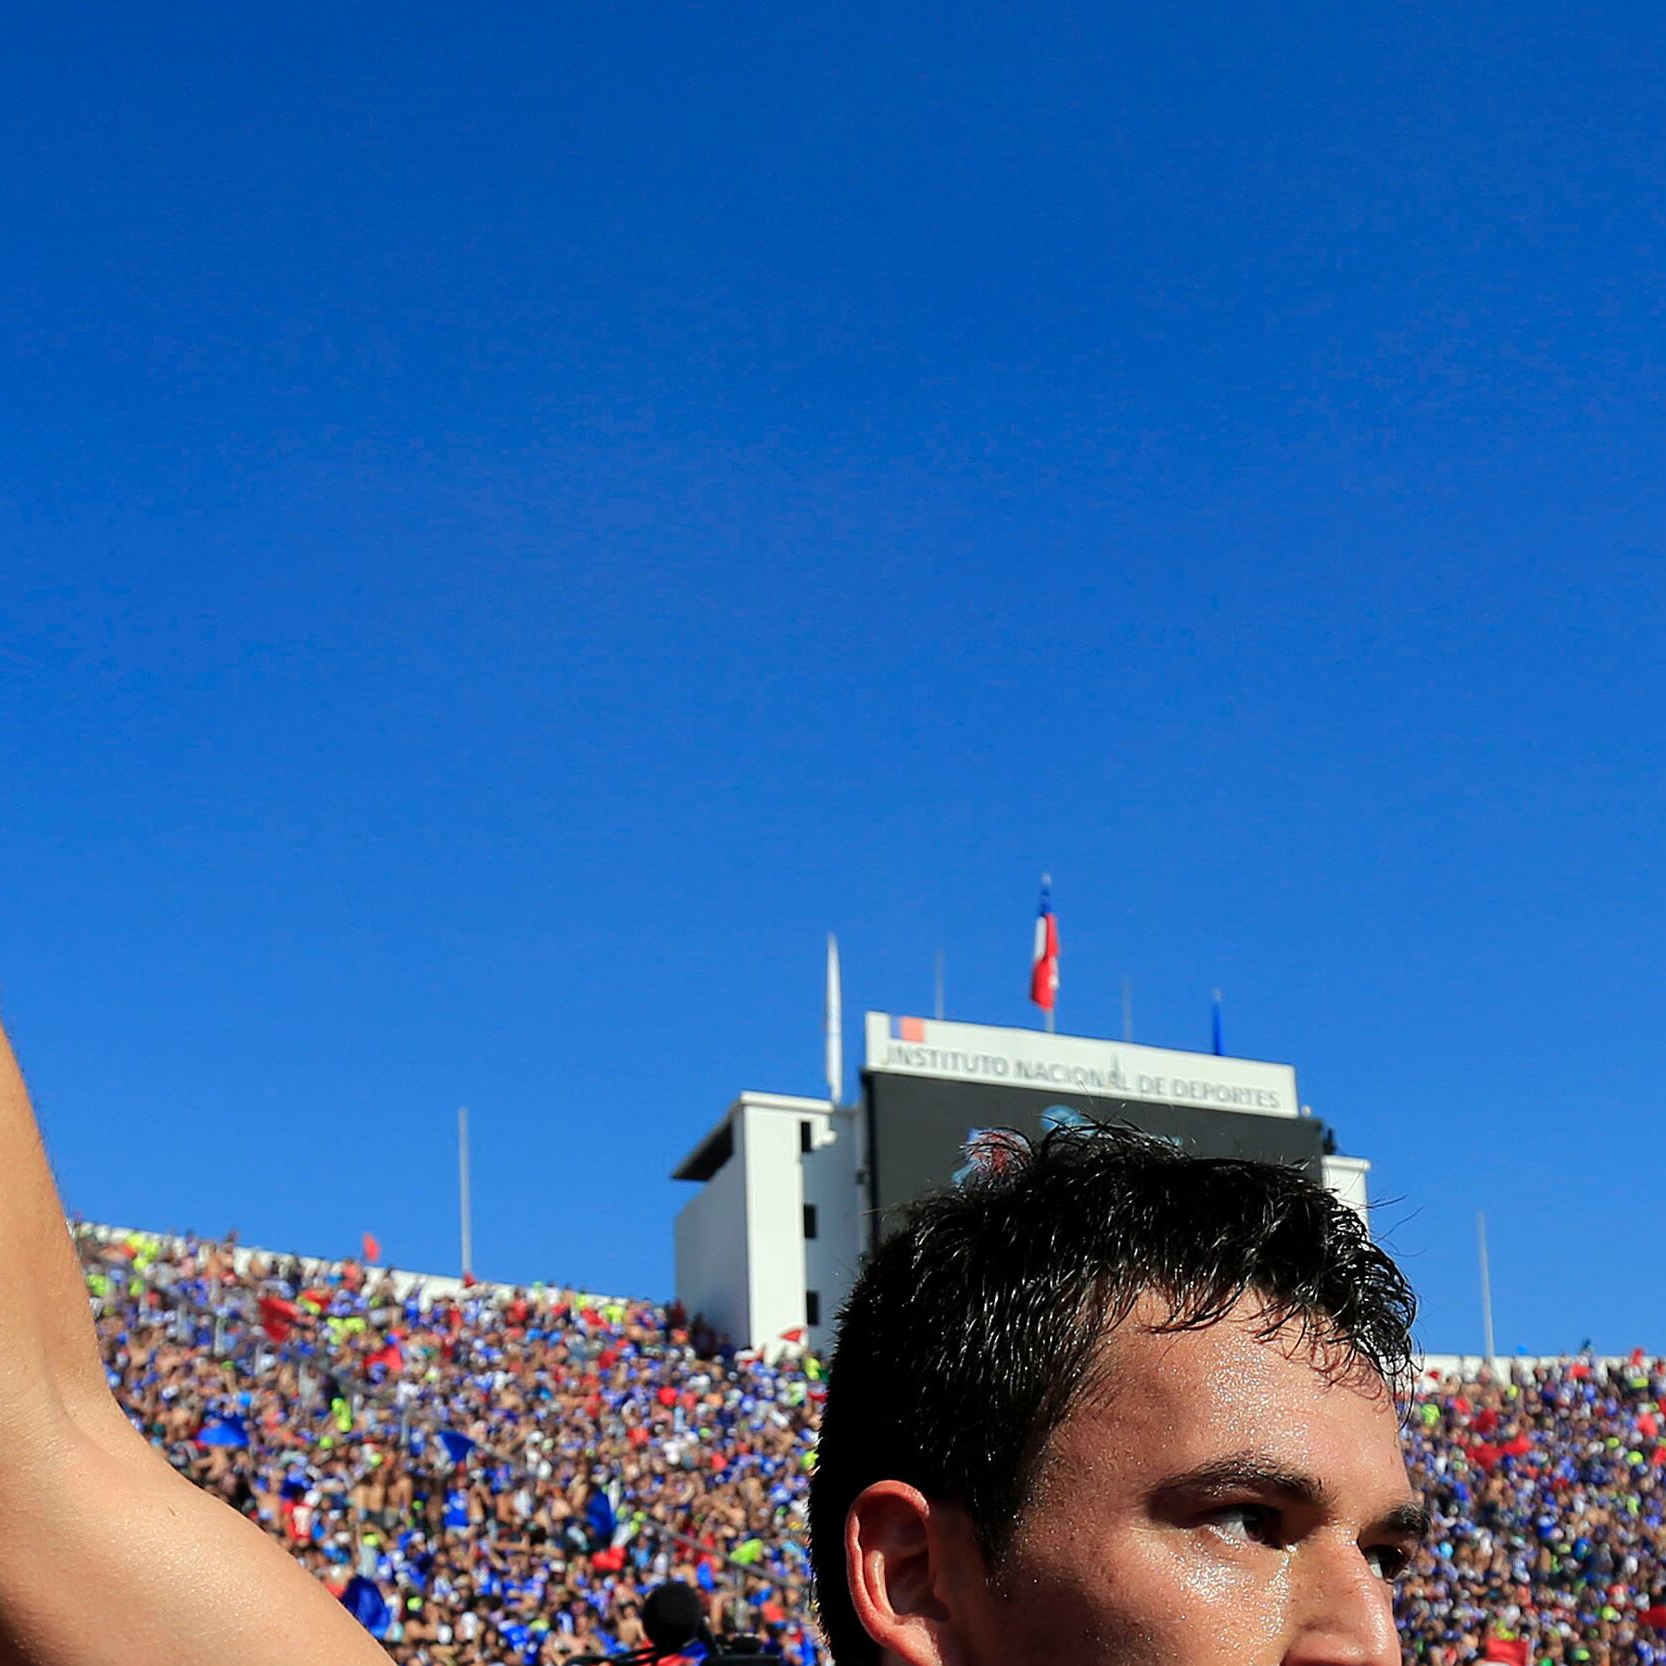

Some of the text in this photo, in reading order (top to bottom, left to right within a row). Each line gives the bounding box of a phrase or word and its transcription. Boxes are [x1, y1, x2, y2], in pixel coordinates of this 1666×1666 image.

[887, 1044, 1281, 1110] INSTITUTO NACIONAL DE DEPORTES
